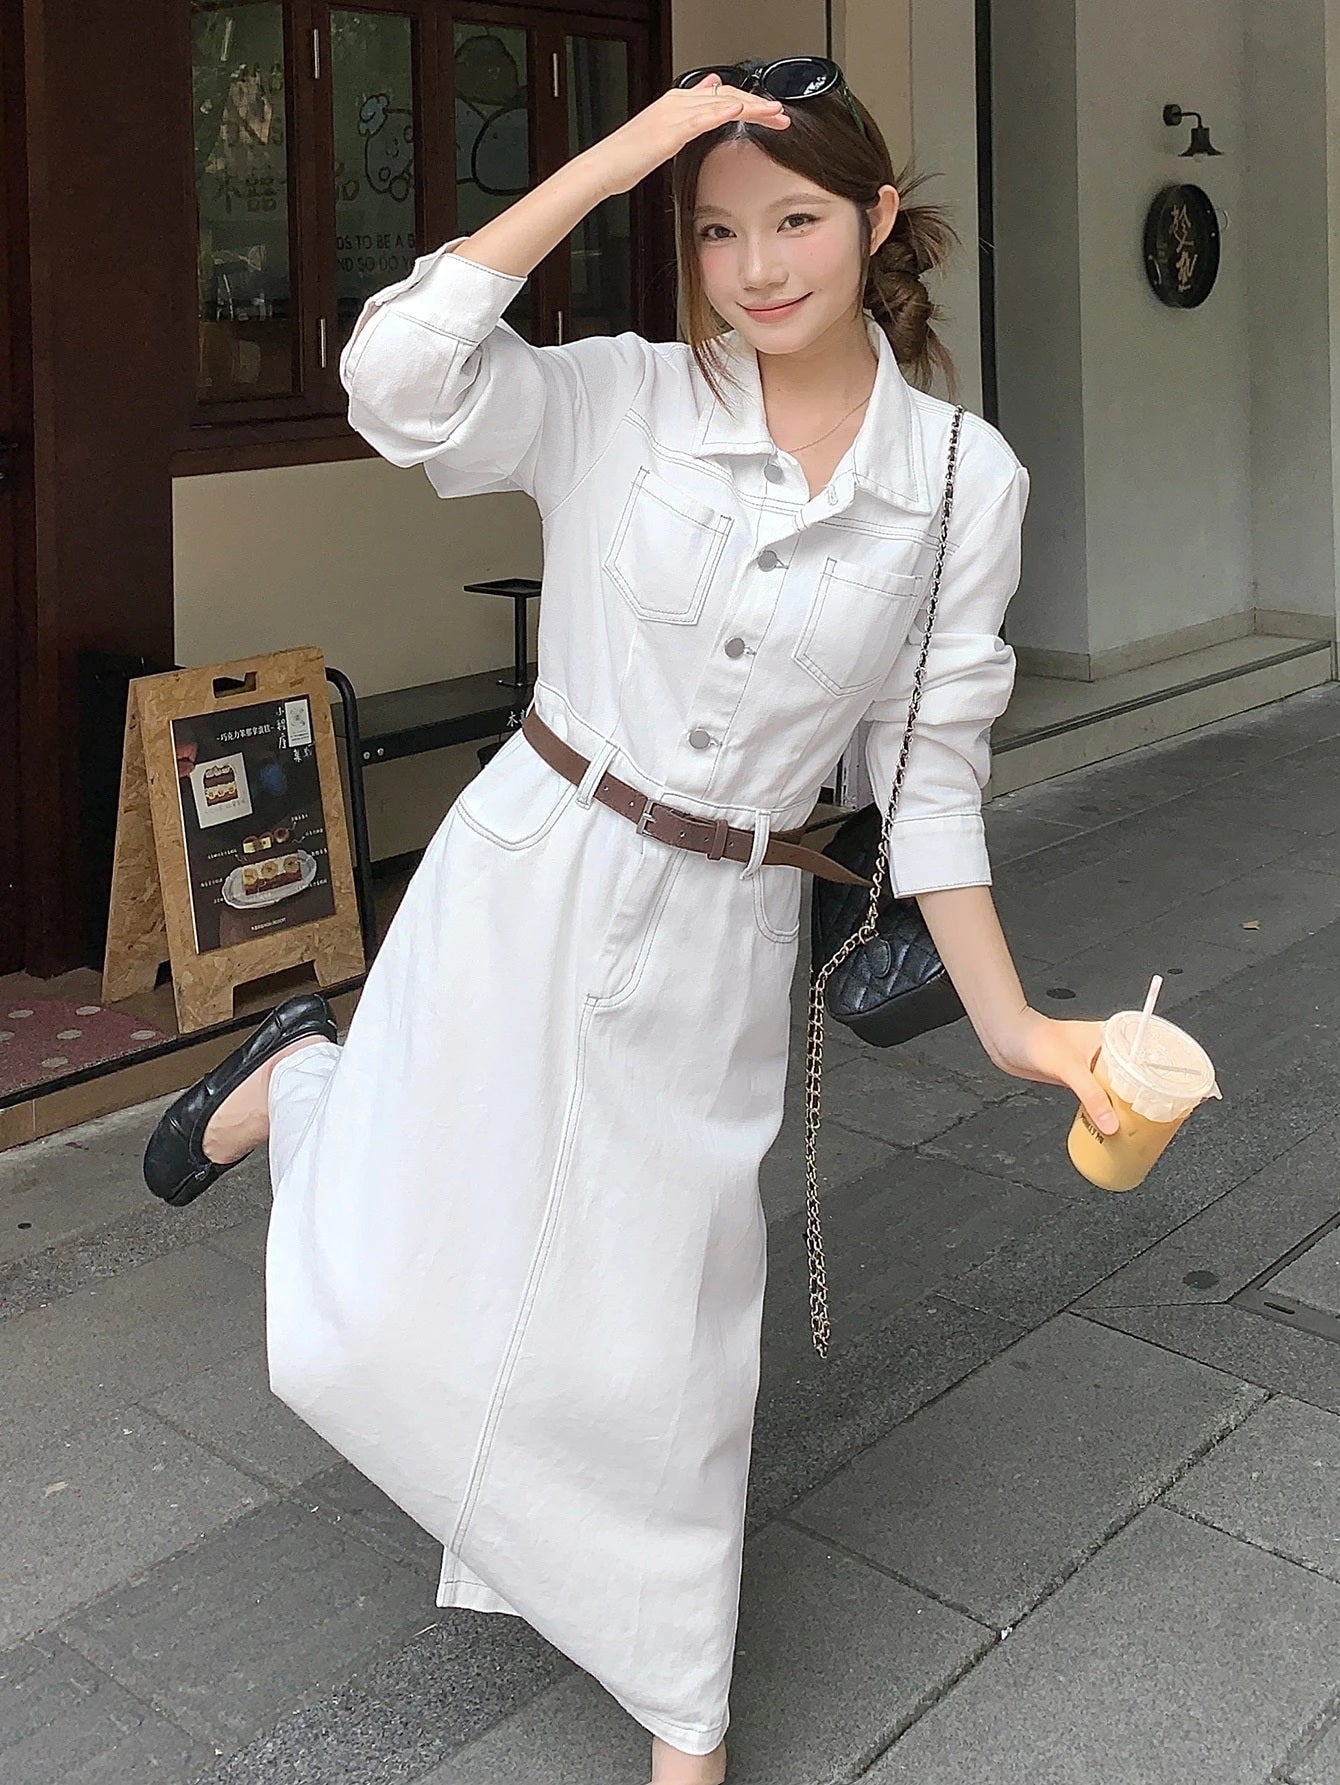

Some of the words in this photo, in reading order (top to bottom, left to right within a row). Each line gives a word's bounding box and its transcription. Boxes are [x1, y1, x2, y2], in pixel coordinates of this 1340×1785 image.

[356, 235, 372, 249] TO
[377, 234, 390, 249] BE
[395, 234, 404, 248] A
[357, 256, 375, 271] SO
[379, 256, 399, 271] DO
